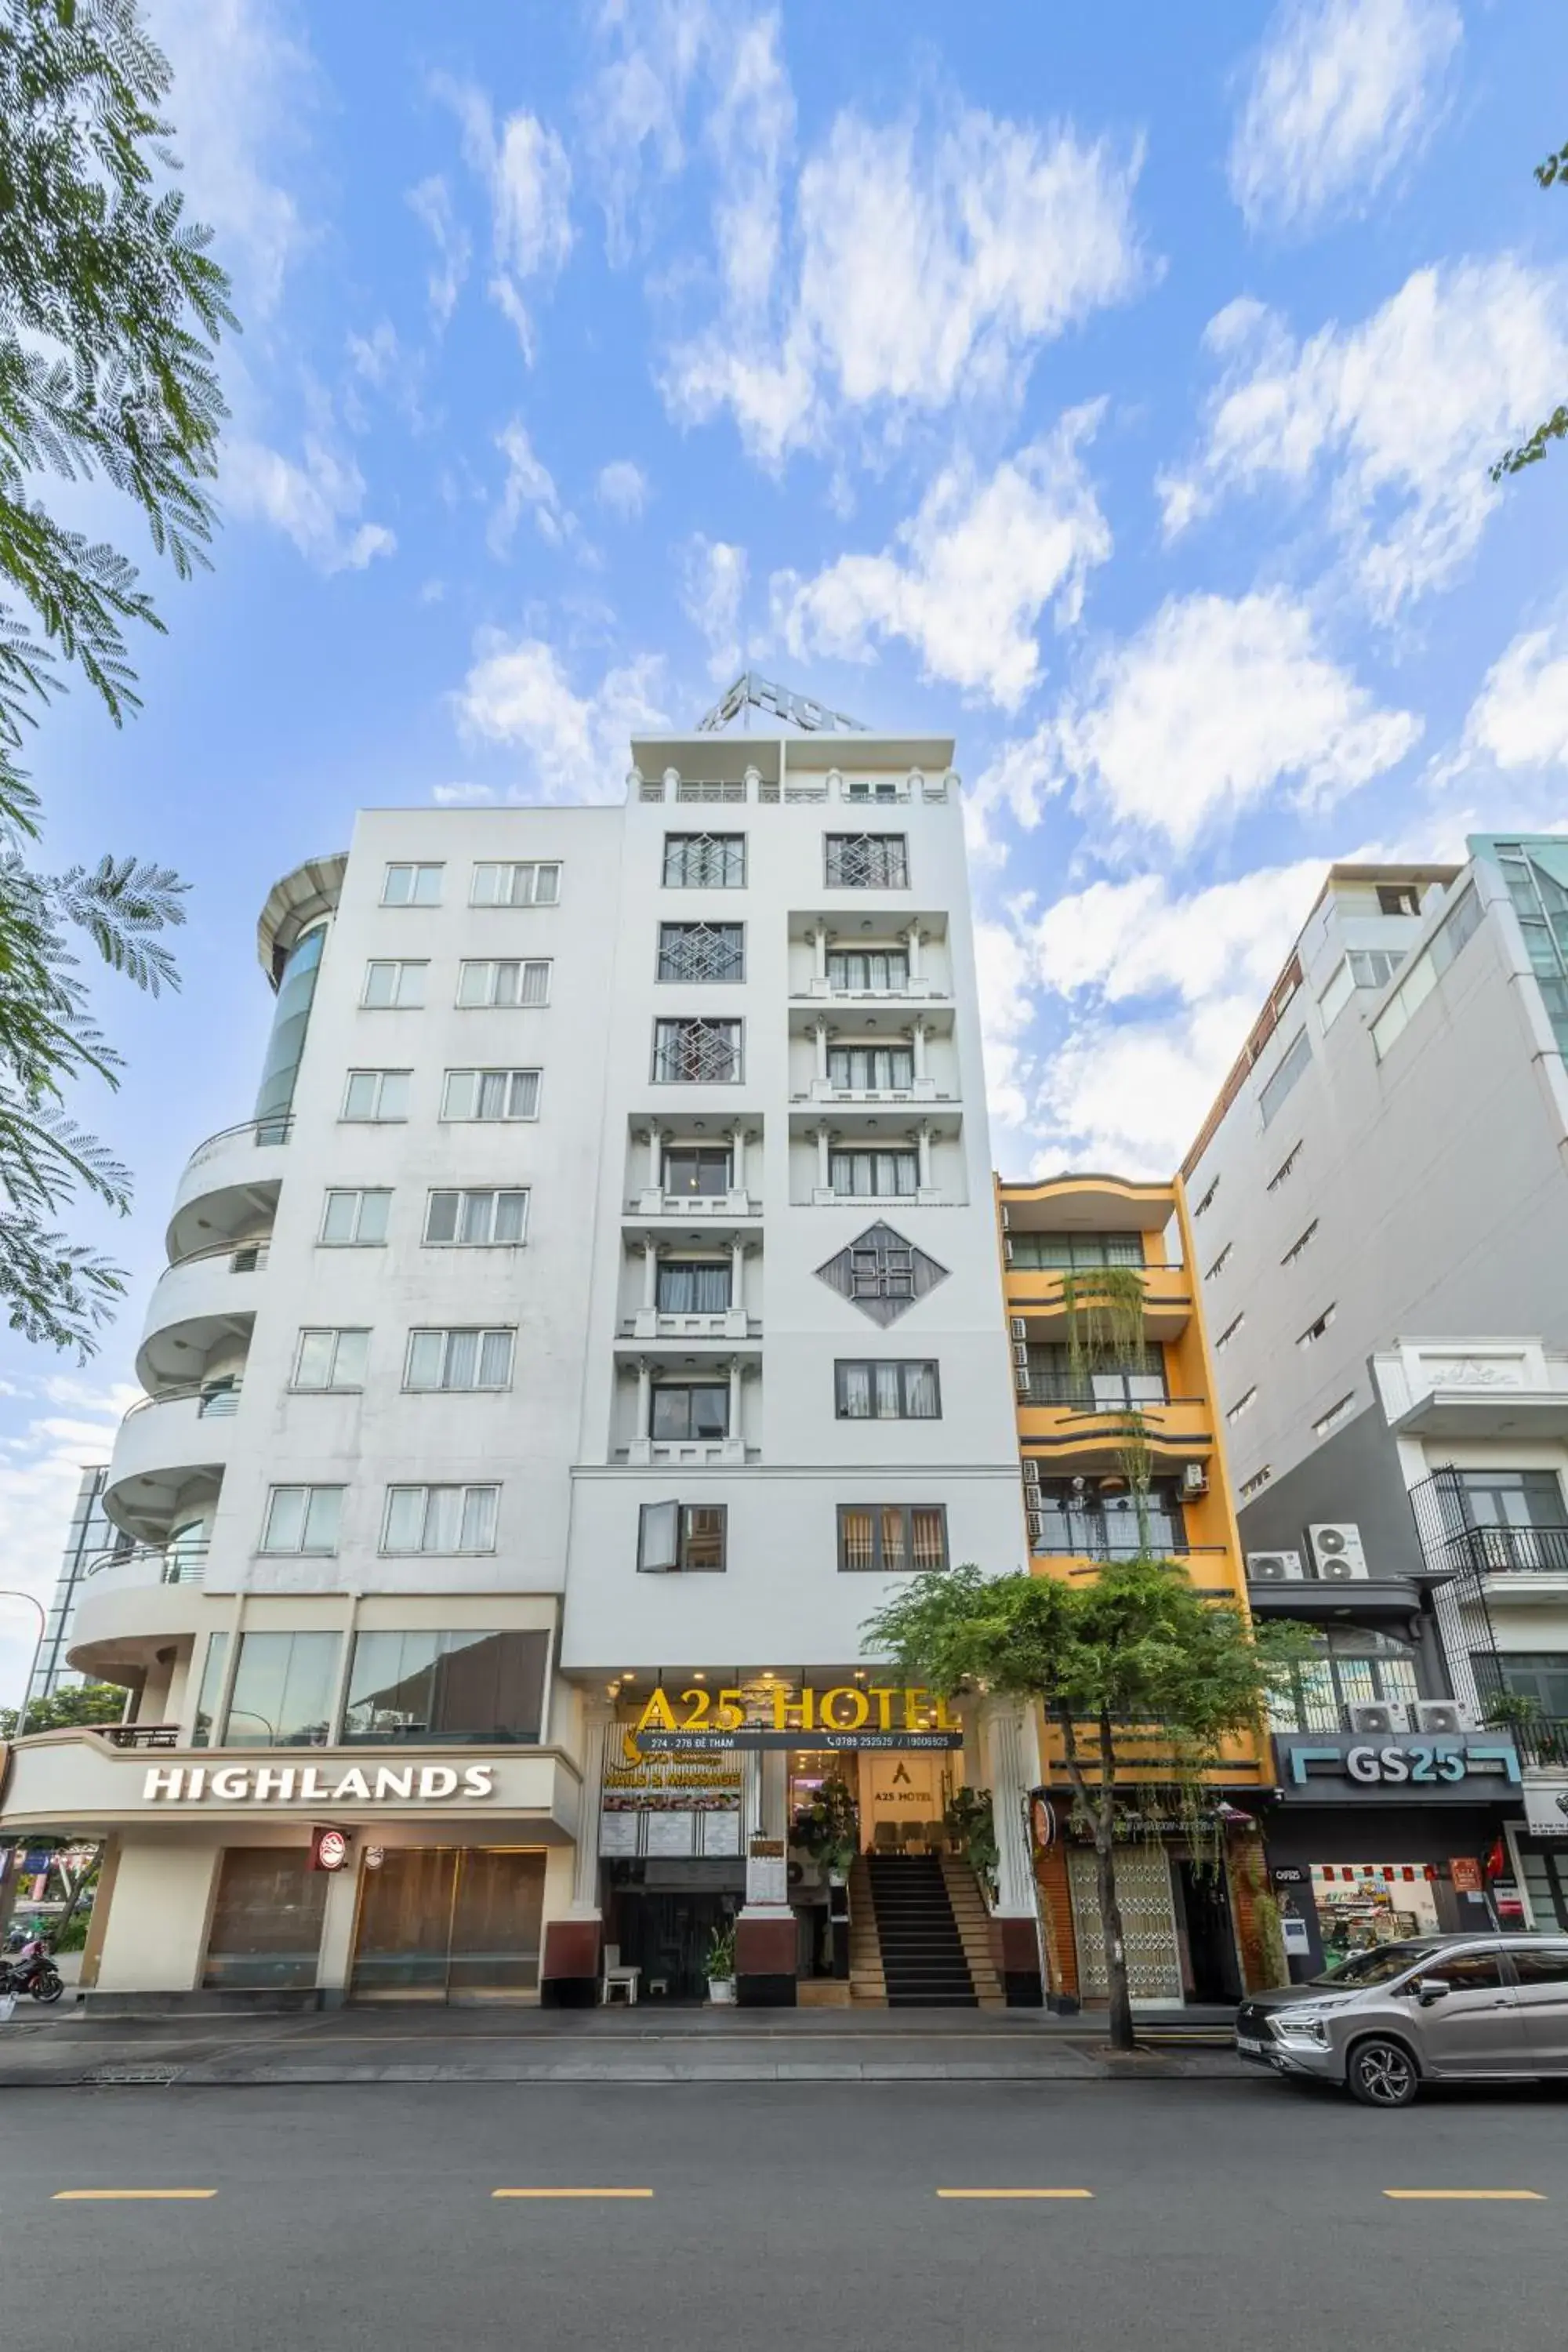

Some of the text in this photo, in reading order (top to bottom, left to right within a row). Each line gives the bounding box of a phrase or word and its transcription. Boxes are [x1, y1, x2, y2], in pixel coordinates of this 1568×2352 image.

[638, 1688, 962, 1730] A25 HOTEL
[1347, 1747, 1465, 1782] GS25
[143, 1766, 492, 1800] HIGHLANDS
[875, 1792, 933, 1801] A25 HOTEL
